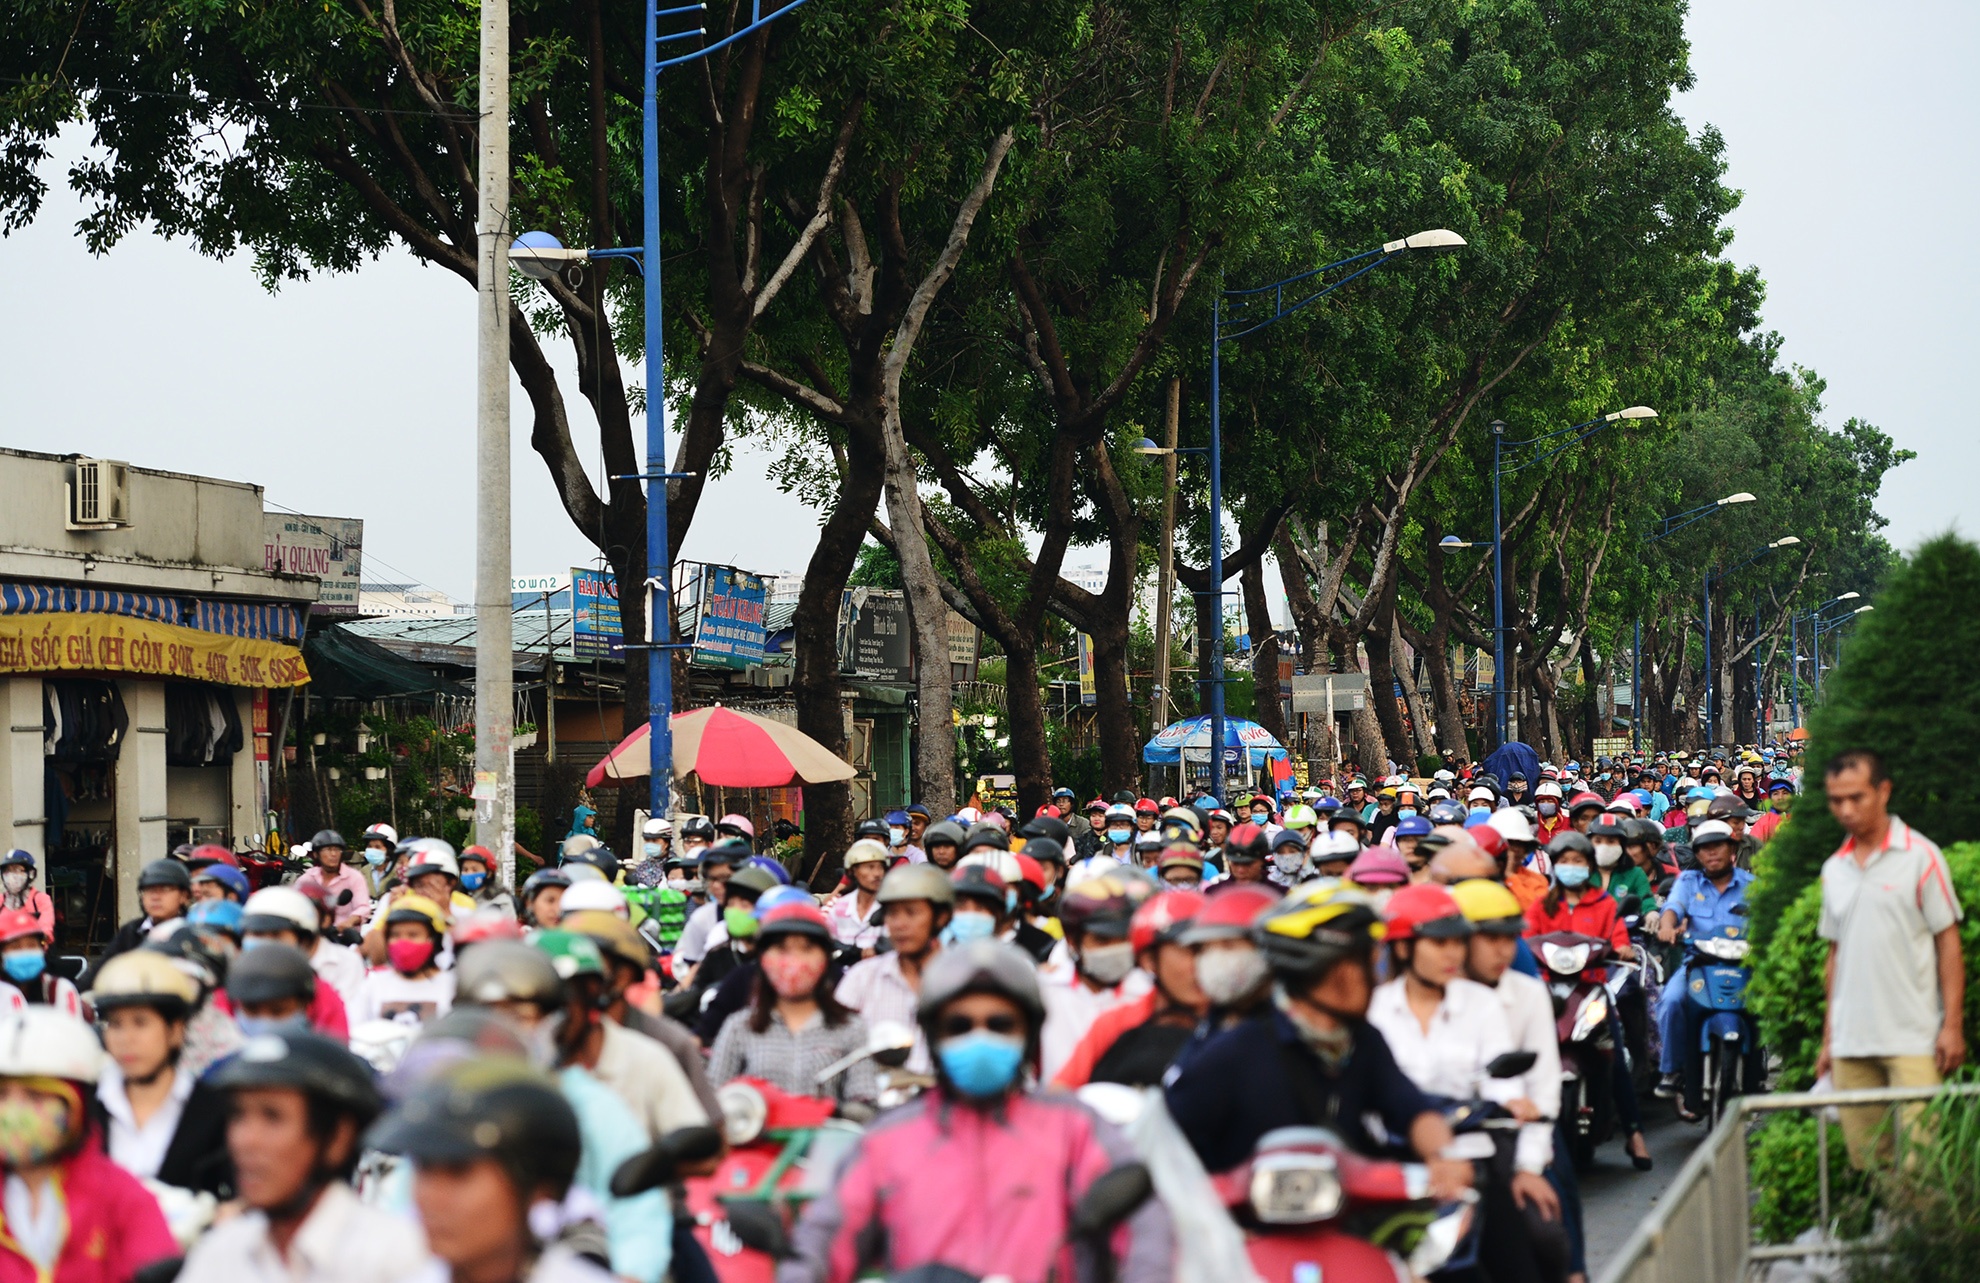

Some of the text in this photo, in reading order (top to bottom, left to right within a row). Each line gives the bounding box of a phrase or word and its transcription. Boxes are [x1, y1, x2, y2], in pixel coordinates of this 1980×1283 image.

[264, 533, 329, 575] HẢI QUANG
[578, 574, 598, 597] HẢI
[736, 598, 763, 625] KHANG
[0, 628, 27, 668] GIÁ
[31, 621, 61, 667] SỐC
[67, 627, 94, 665] GIÁ
[98, 626, 125, 666] CHỈ
[130, 632, 163, 670] CÒN
[168, 643, 195, 675] 30K
[205, 651, 230, 683] 40K
[239, 654, 264, 683] 50K
[269, 655, 301, 684] 60K
